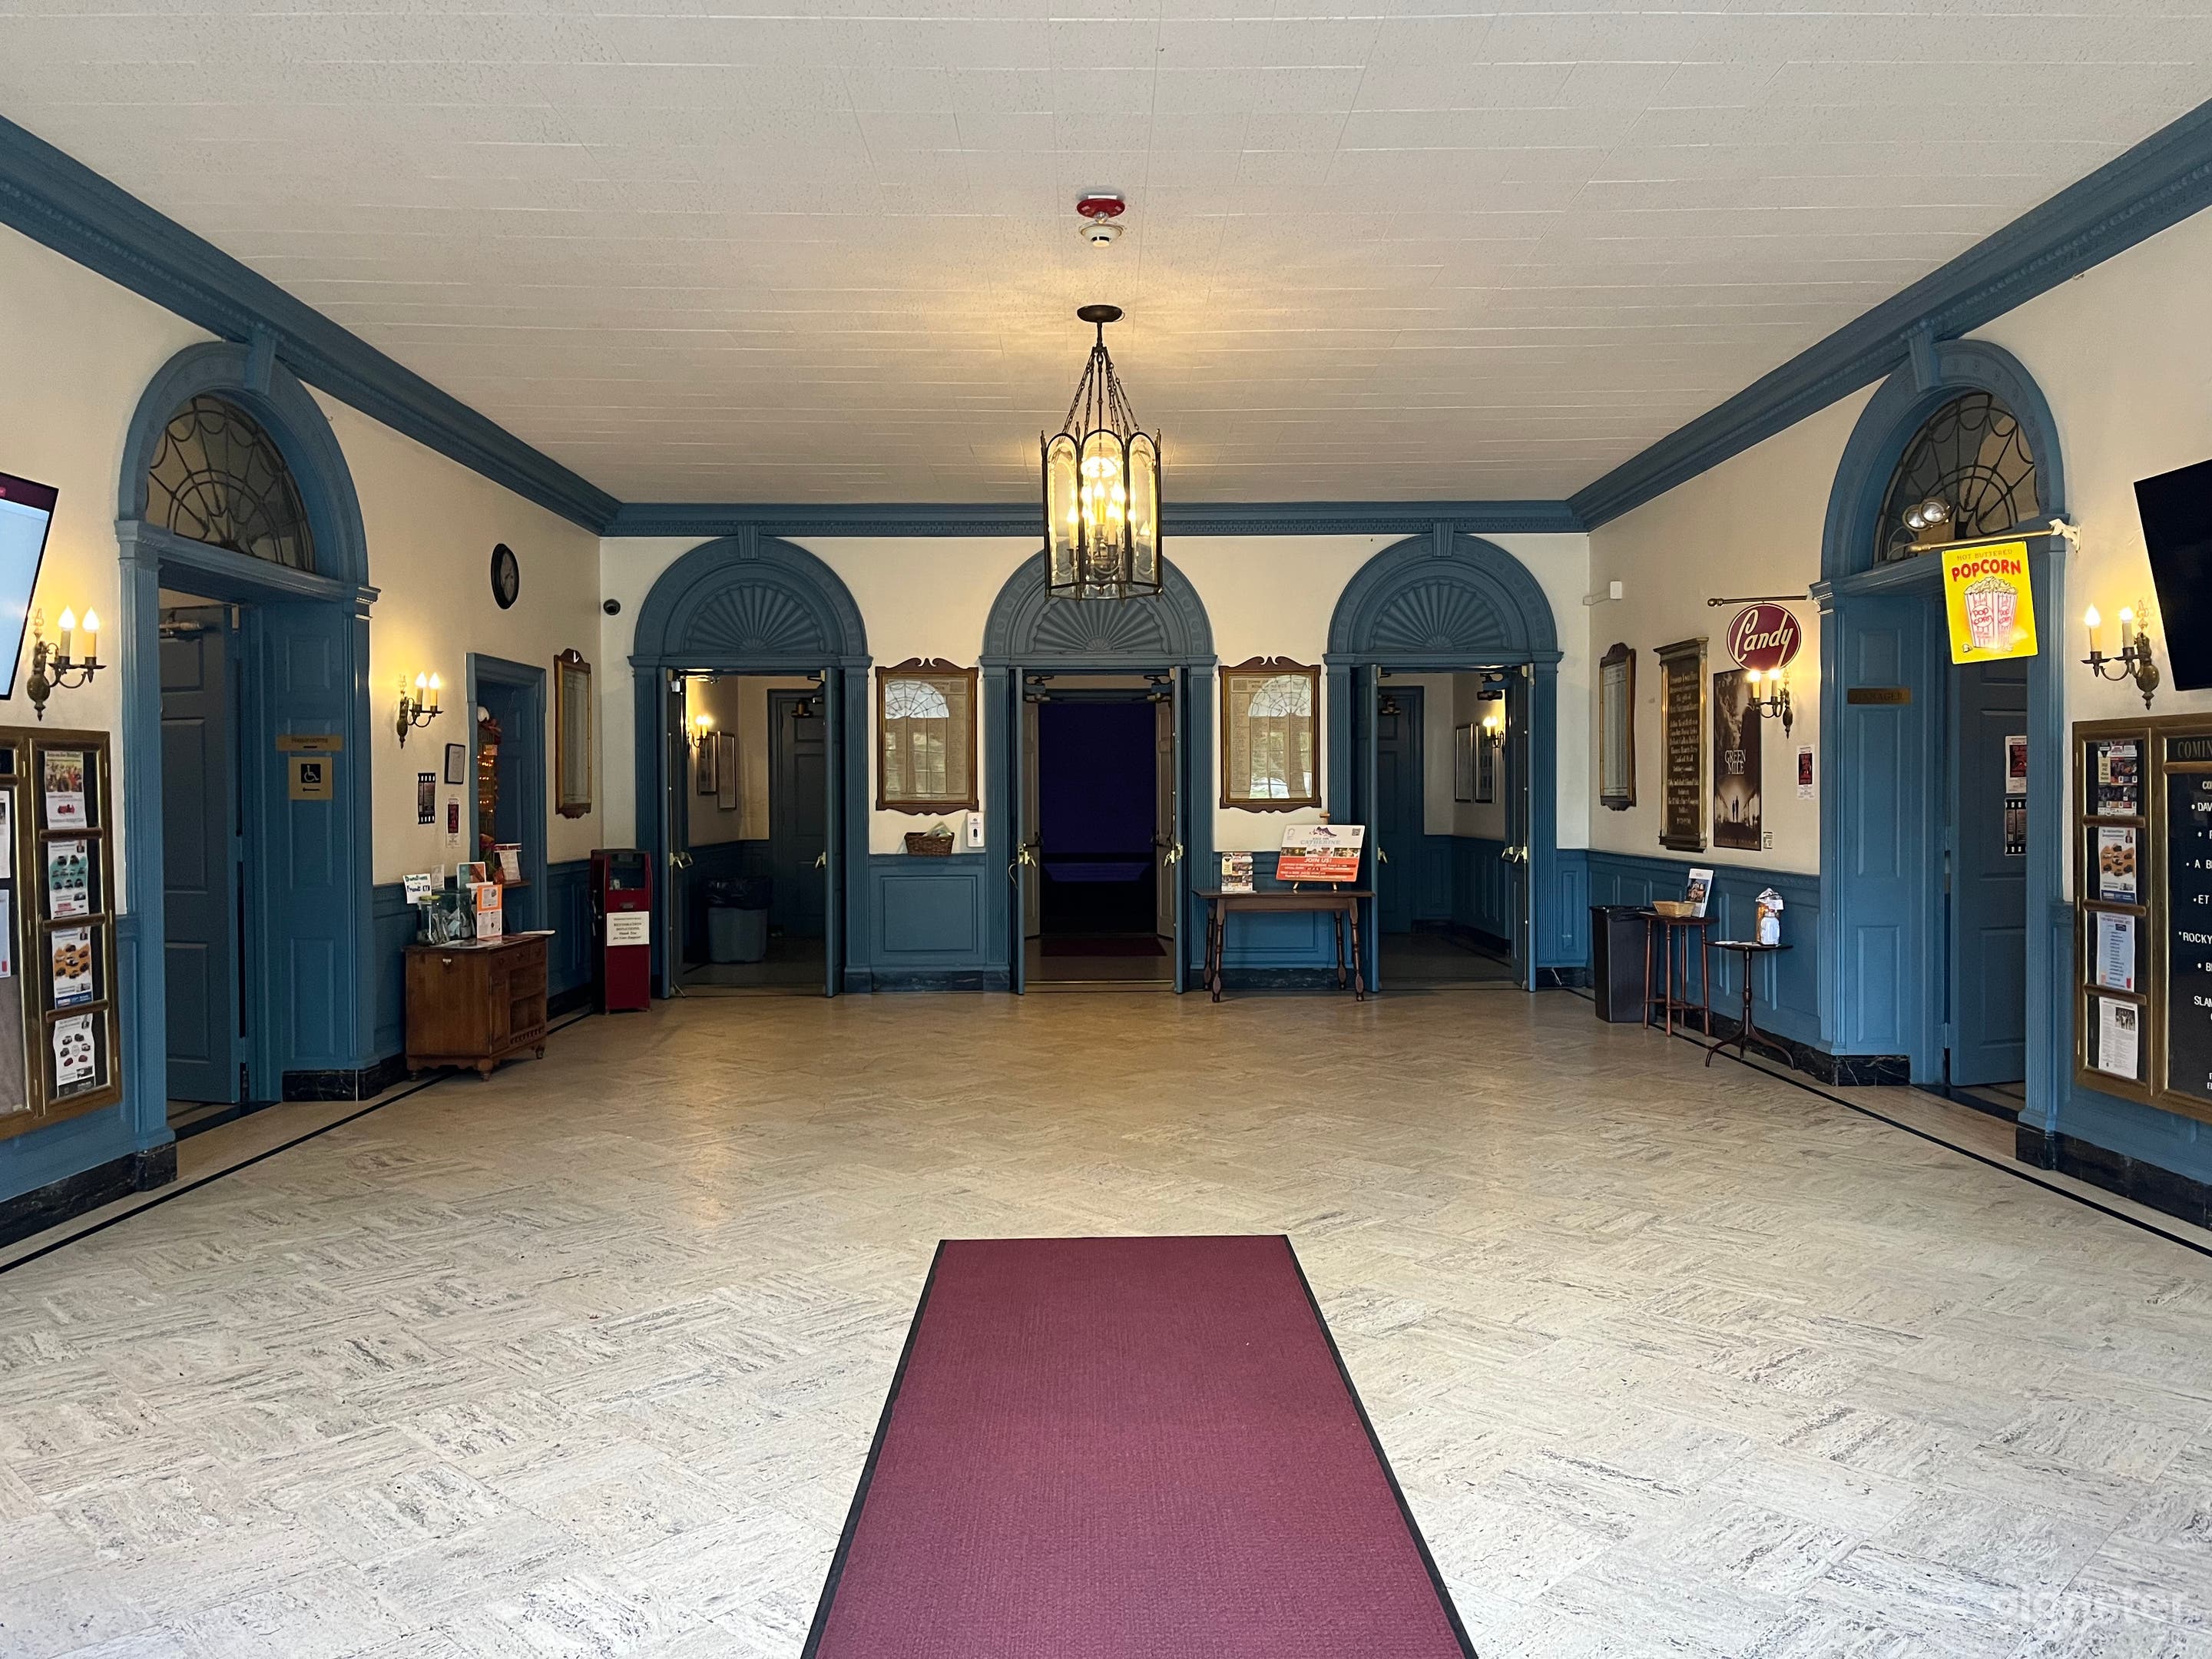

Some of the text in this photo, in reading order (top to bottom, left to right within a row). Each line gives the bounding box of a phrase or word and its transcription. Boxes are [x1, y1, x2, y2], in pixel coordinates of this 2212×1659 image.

[1975, 549, 2012, 558] BUTTERED
[1952, 559, 2022, 581] POPCORN
[1734, 609, 1794, 668] Candy
[1724, 750, 1747, 763] GREEN
[1727, 761, 1744, 775] MILE
[2194, 859, 2200, 869] A
[2198, 895, 2210, 905] ET
[2183, 932, 2212, 945] ROCKY
